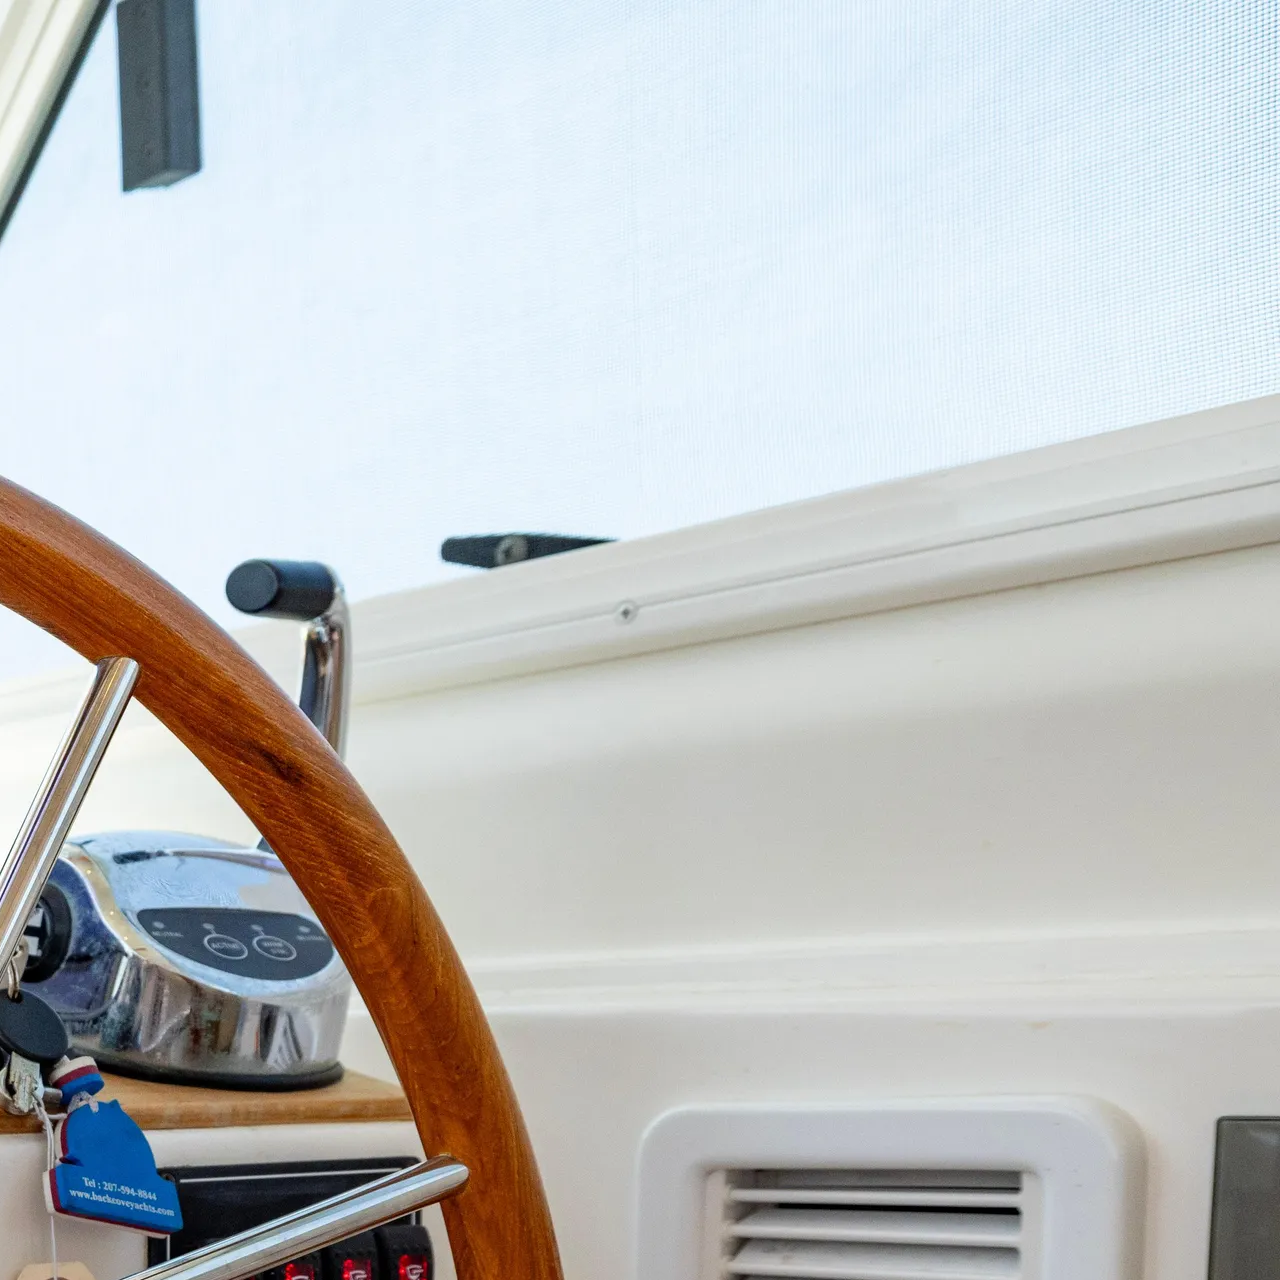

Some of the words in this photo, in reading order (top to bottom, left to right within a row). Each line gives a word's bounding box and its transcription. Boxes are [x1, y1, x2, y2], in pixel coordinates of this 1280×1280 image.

[82, 1177, 96, 1188] Tel
[103, 1181, 157, 1201] 207-594-8844
[69, 1189, 175, 1217] www.backcoveyachts.com
